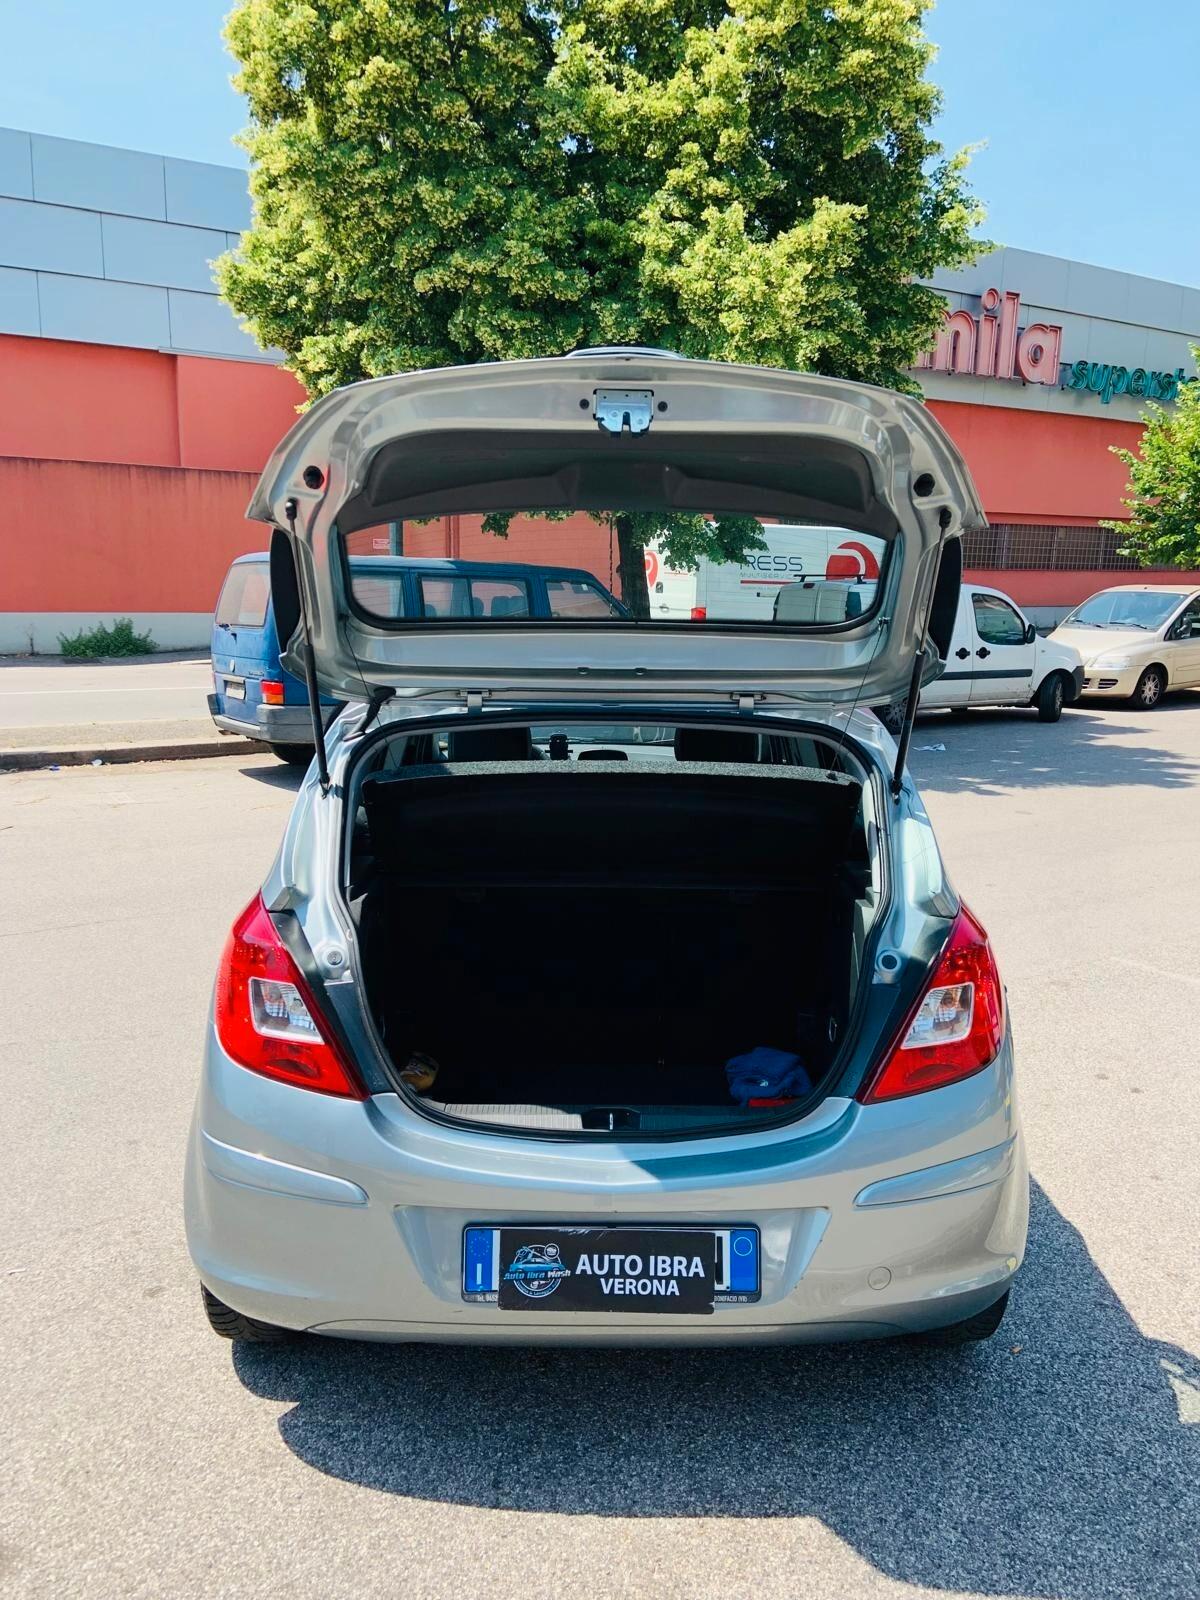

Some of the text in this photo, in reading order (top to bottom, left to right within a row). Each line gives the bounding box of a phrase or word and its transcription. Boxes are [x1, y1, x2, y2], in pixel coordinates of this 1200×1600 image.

[912, 288, 1199, 404] mila superst
[740, 555, 803, 571] RESS
[575, 1254, 643, 1276] AUTO
[649, 1255, 705, 1277] IBRA
[600, 1278, 680, 1296] VERONA
